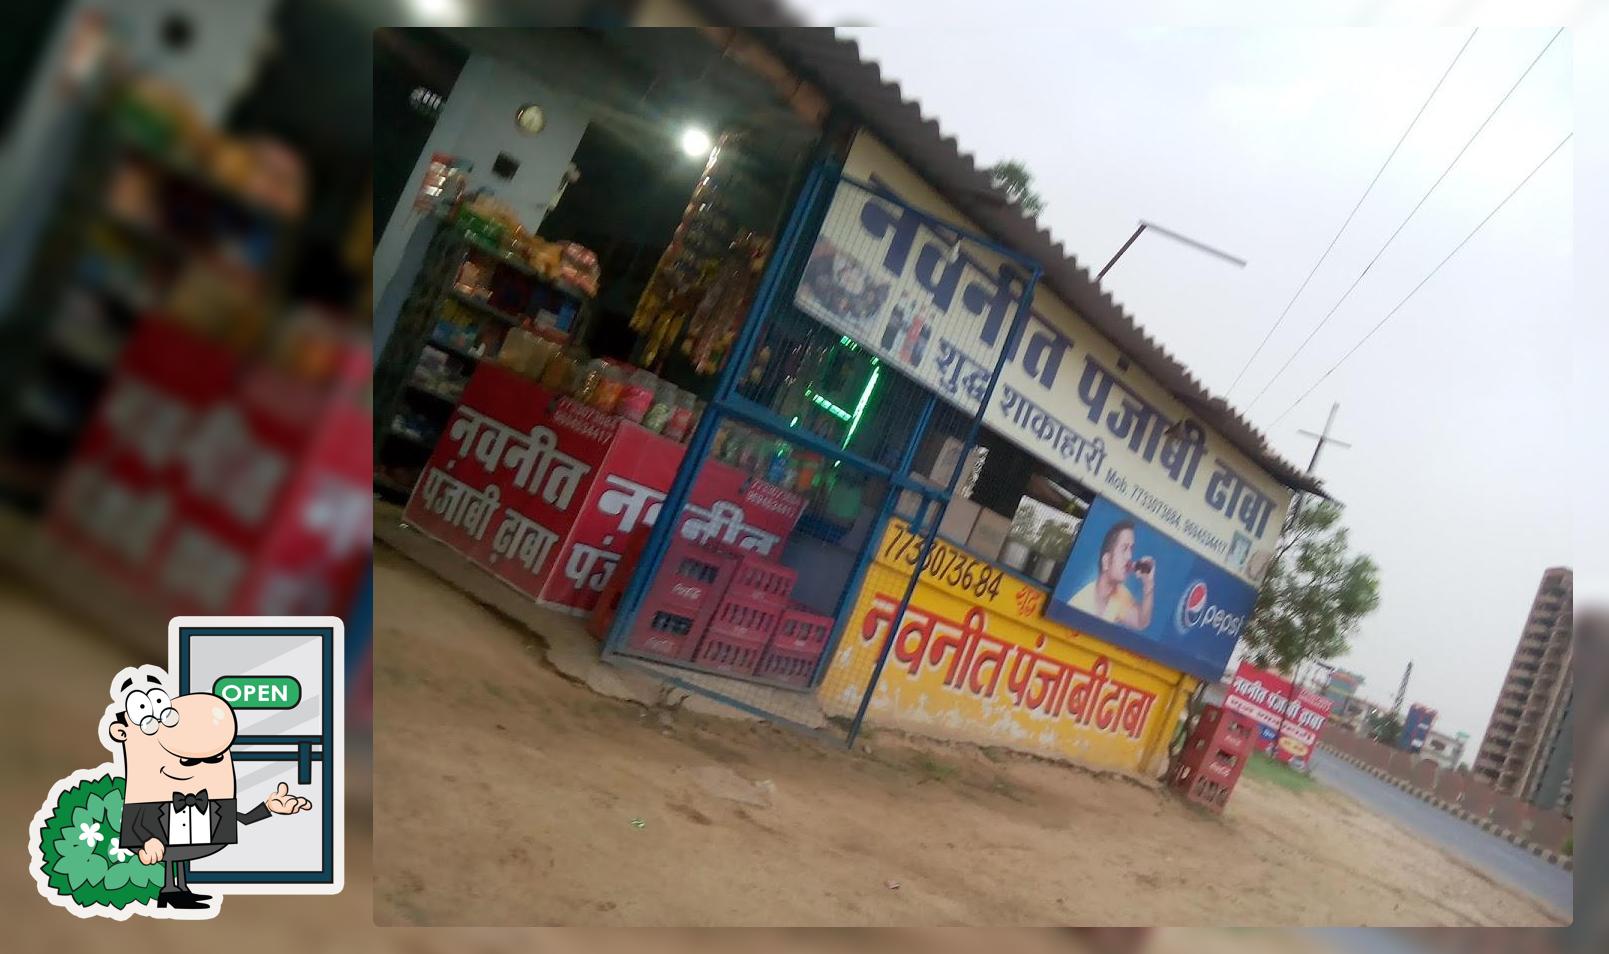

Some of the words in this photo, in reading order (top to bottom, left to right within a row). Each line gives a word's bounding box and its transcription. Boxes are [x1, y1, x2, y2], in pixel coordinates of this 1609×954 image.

[860, 171, 1074, 391] नवनीत
[1078, 353, 1207, 490] पंजाबी
[1205, 457, 1278, 540] ढाबा
[451, 404, 592, 511] नवनीत
[1000, 383, 1107, 477] शाकाहारी
[422, 460, 501, 541] पंजाबी
[862, 591, 1015, 698] नवनीत
[1008, 632, 1110, 726] पंजाबी
[1095, 679, 1158, 739] ढाबा
[1199, 605, 1245, 638] pepsi
